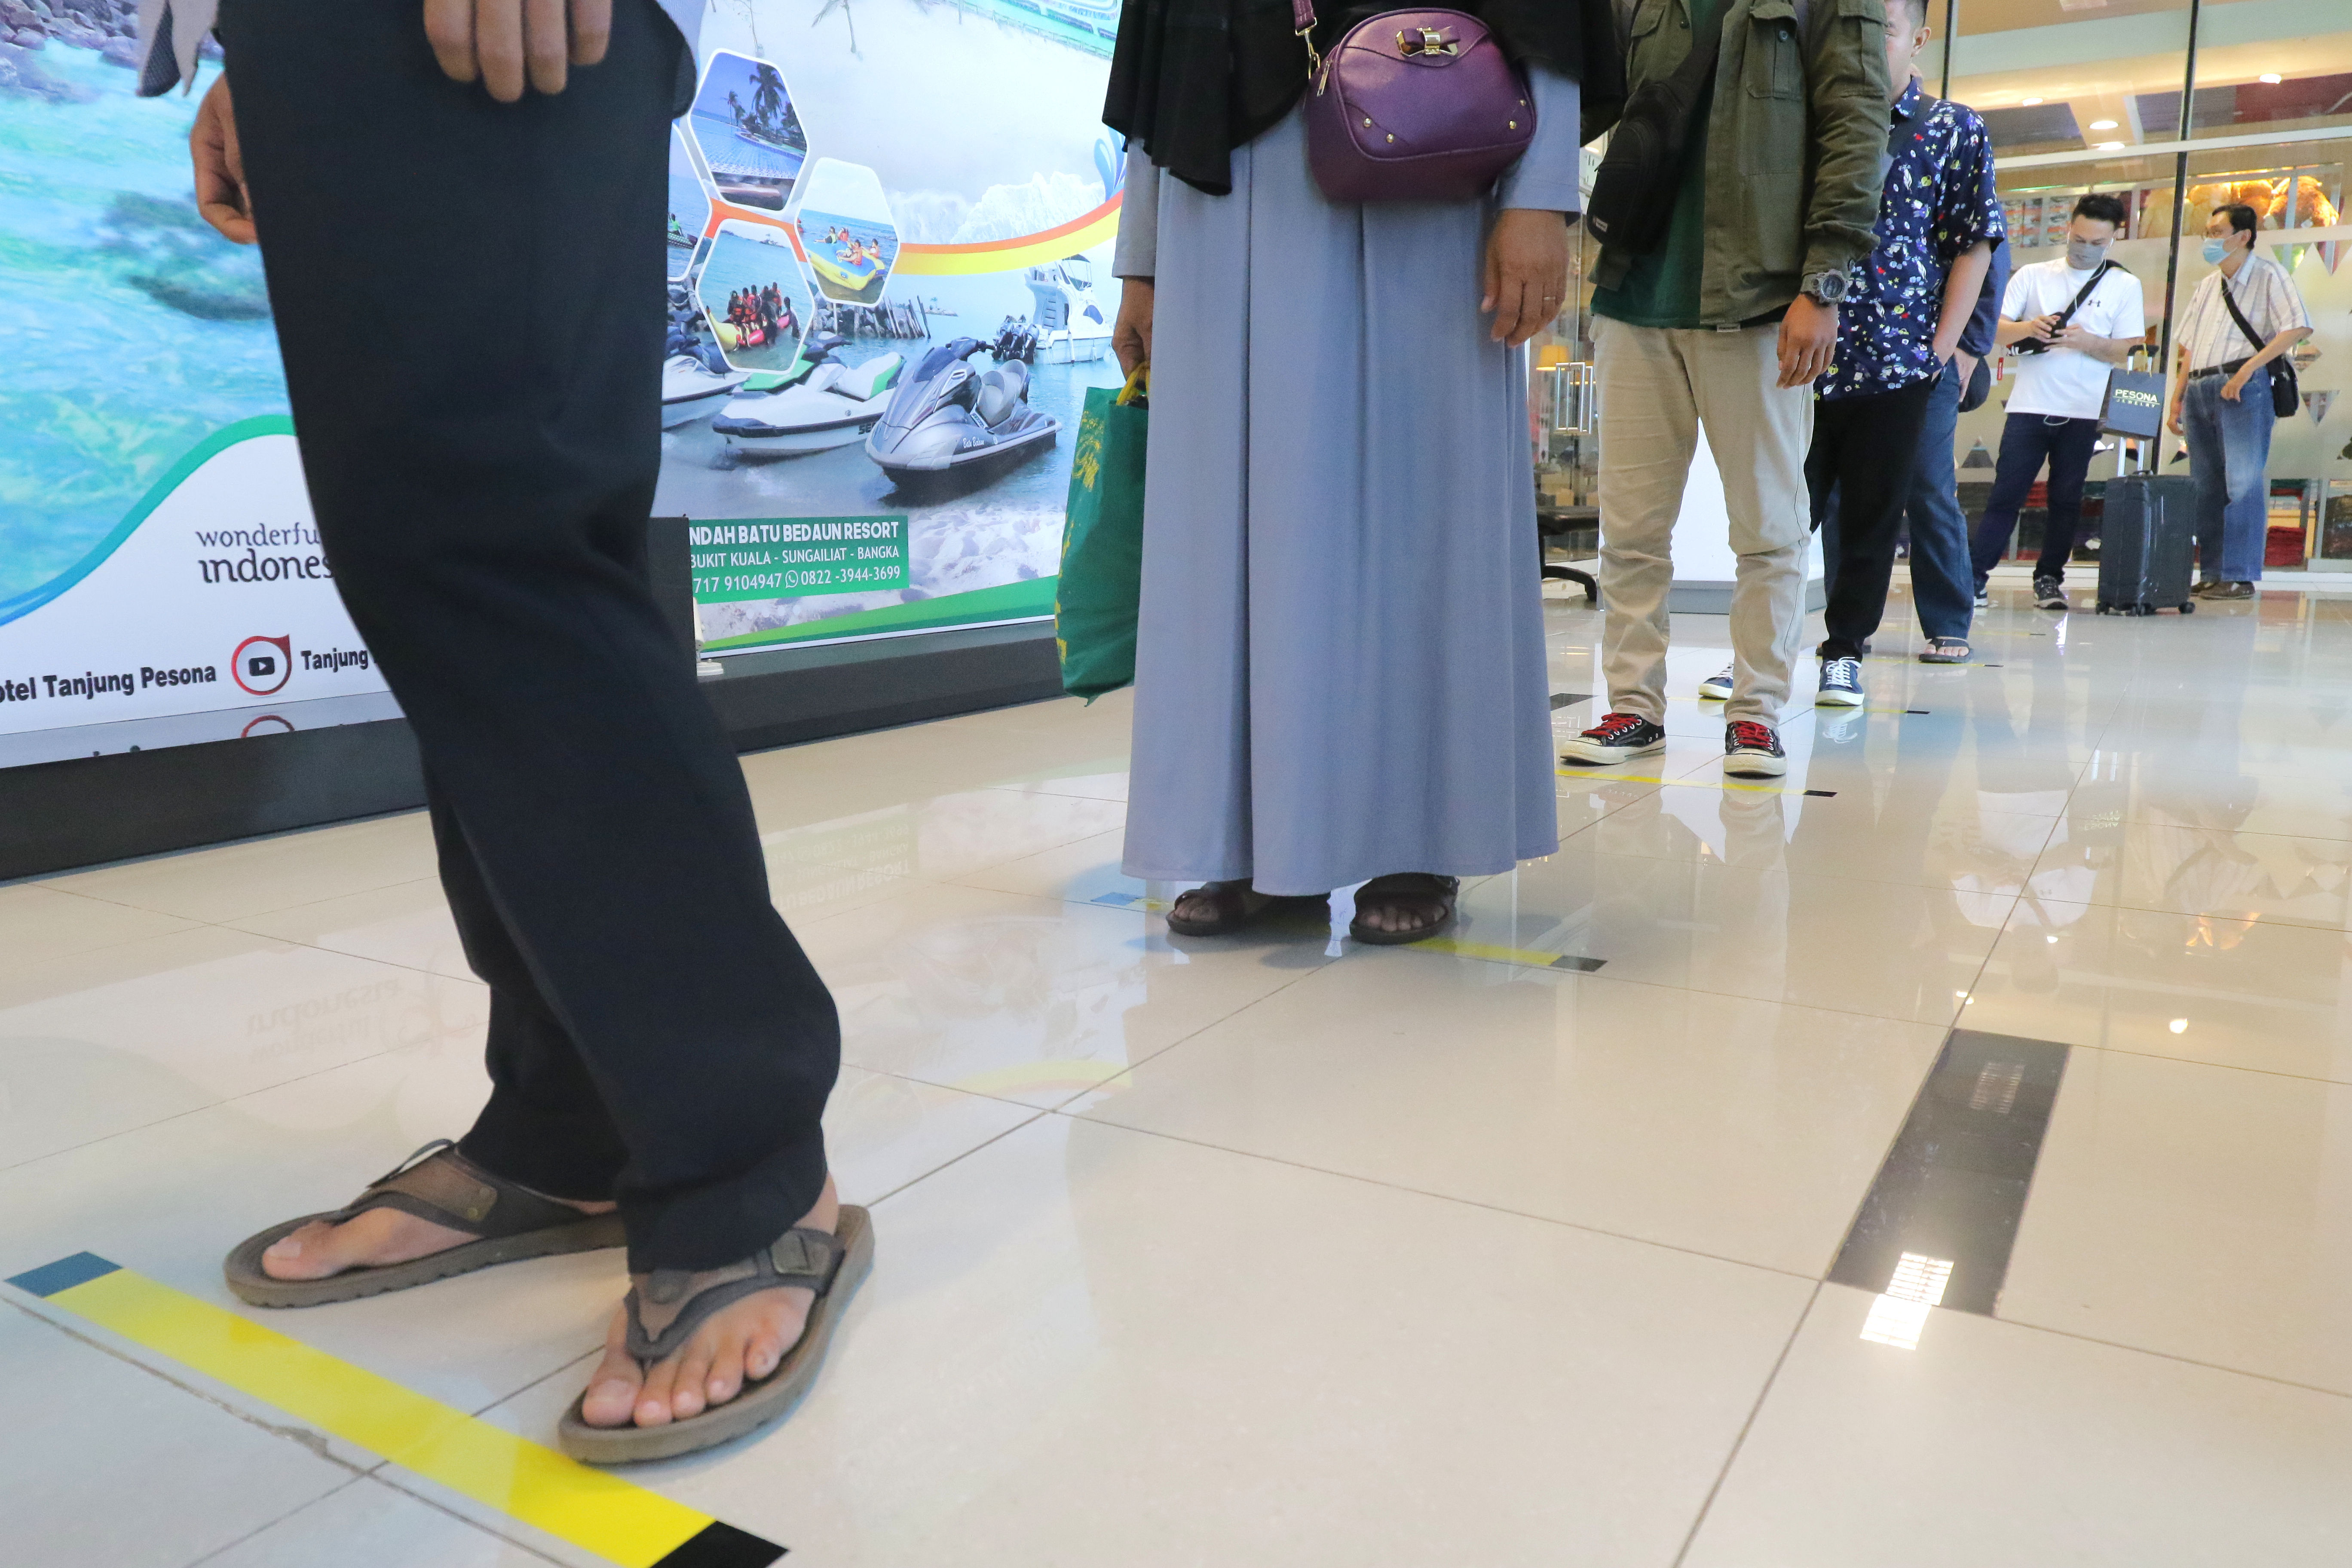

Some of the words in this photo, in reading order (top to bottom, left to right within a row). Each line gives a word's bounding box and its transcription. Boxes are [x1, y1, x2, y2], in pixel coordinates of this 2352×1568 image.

[2115, 389, 2157, 403] PESONA
[2116, 399, 2156, 408] JEWELRY
[195, 521, 321, 547] wonderfu
[689, 526, 735, 545] NDAH
[738, 524, 781, 544] BATU
[783, 523, 841, 542] BEDAUN
[844, 521, 899, 540] RESORT
[198, 548, 334, 583] indones
[690, 553, 726, 568] BUKIT
[731, 551, 771, 567] KUALA
[782, 547, 847, 564] SUNGAILIAT
[858, 545, 899, 560] BANGKA
[693, 577, 719, 593] 717
[724, 573, 782, 591] 9104947
[801, 570, 831, 585] 0822
[300, 647, 368, 673] Tanjung
[42, 671, 134, 700] Tanjung
[140, 666, 217, 689] Pesona
